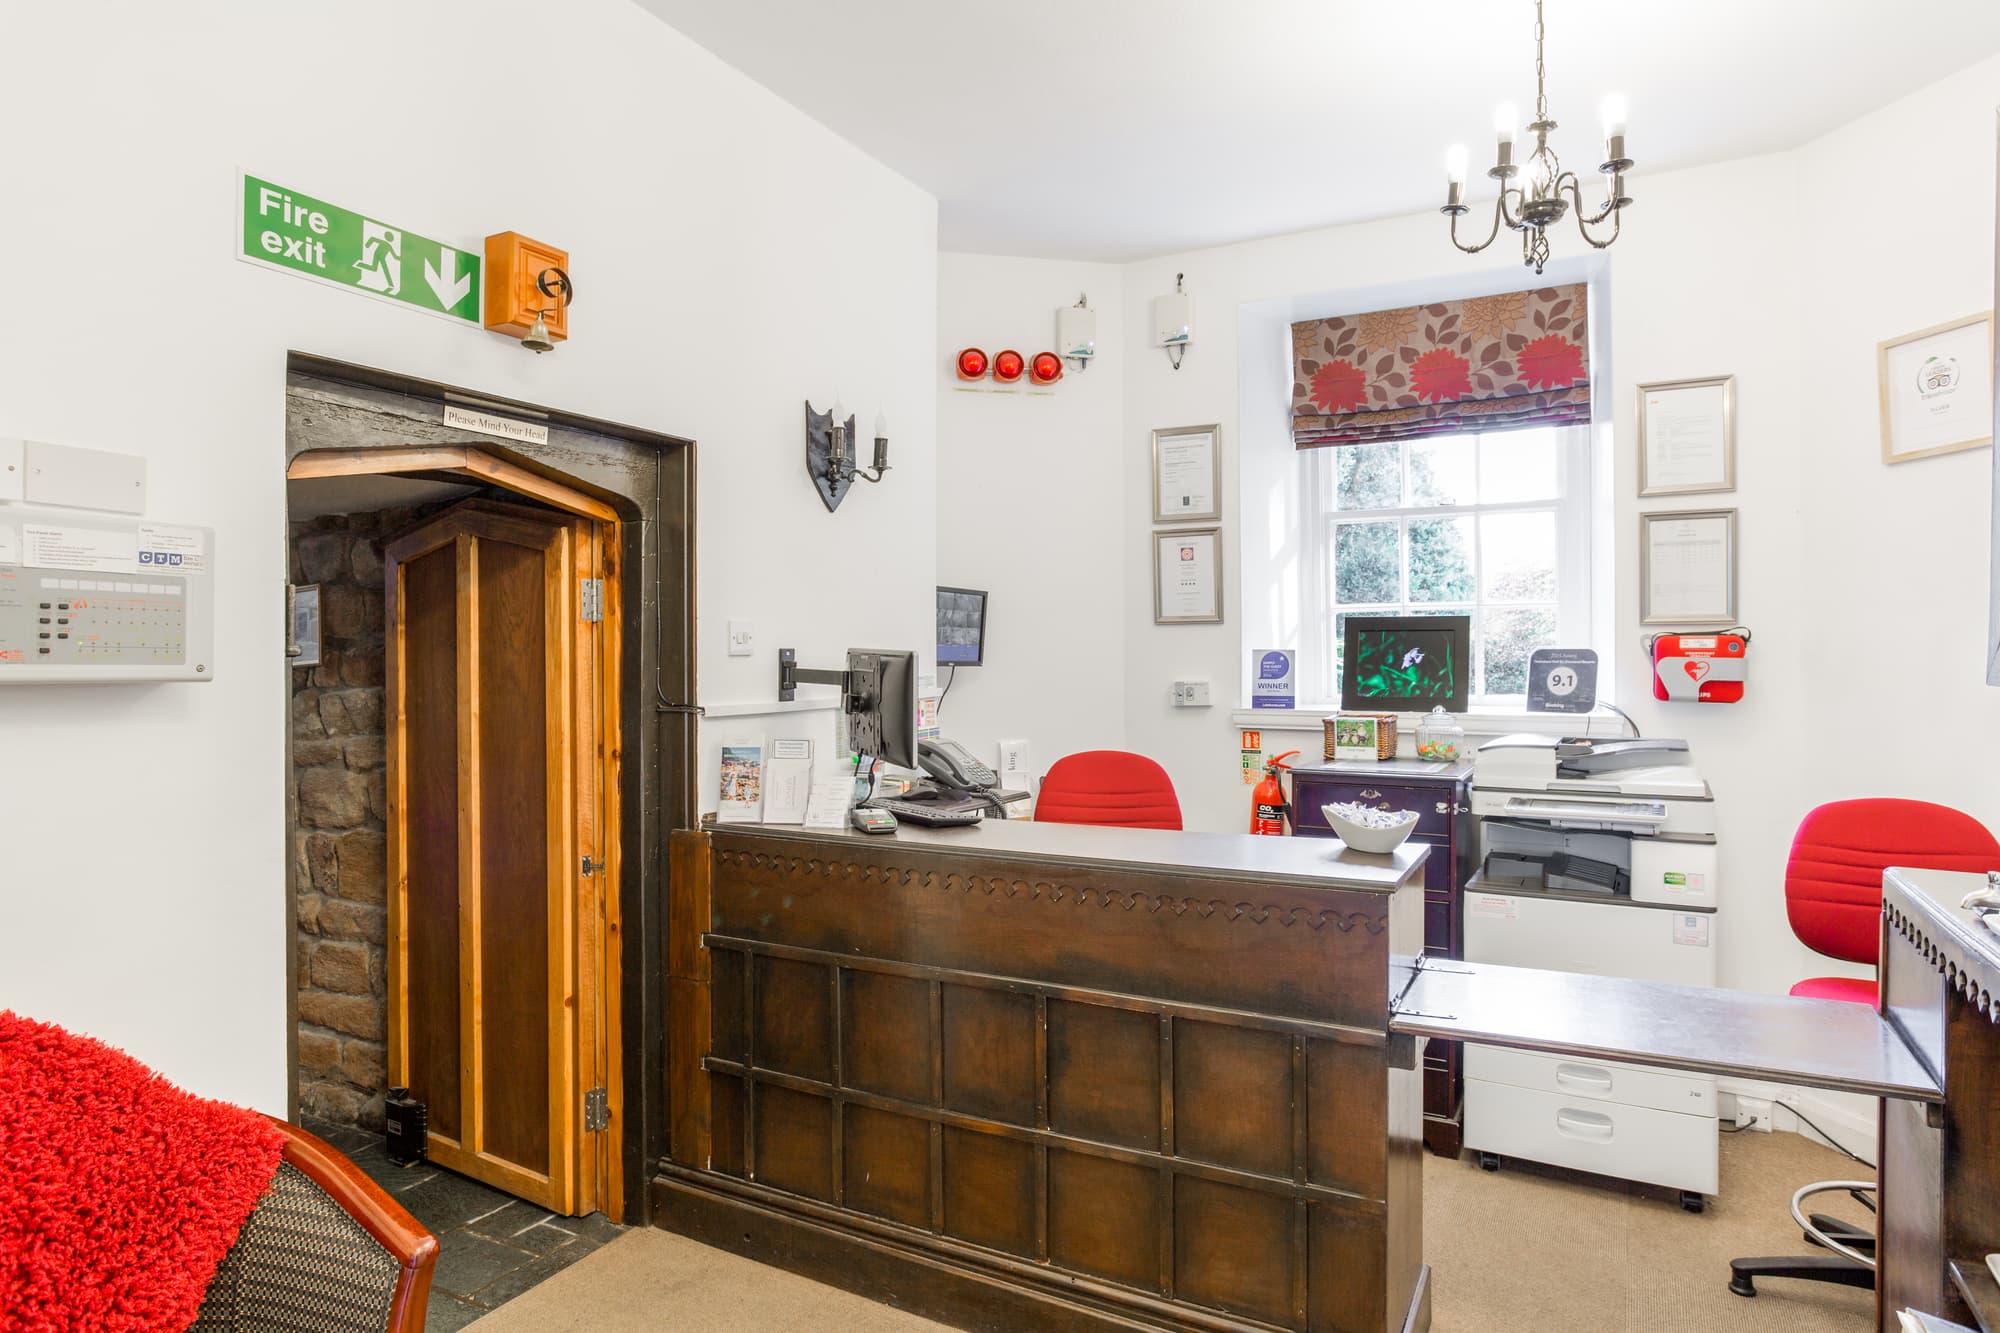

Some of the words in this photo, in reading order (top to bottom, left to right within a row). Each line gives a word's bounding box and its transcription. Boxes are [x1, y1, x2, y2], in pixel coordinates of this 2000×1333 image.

[260, 186, 328, 234] Fire
[261, 230, 326, 269] exit
[448, 411, 476, 426] Please
[479, 418, 501, 432] Mind
[503, 423, 523, 436] Your
[524, 427, 546, 441] Head
[139, 551, 182, 565] CTM
[1257, 682, 1289, 690] WINNER
[1552, 674, 1573, 687] 9.1
